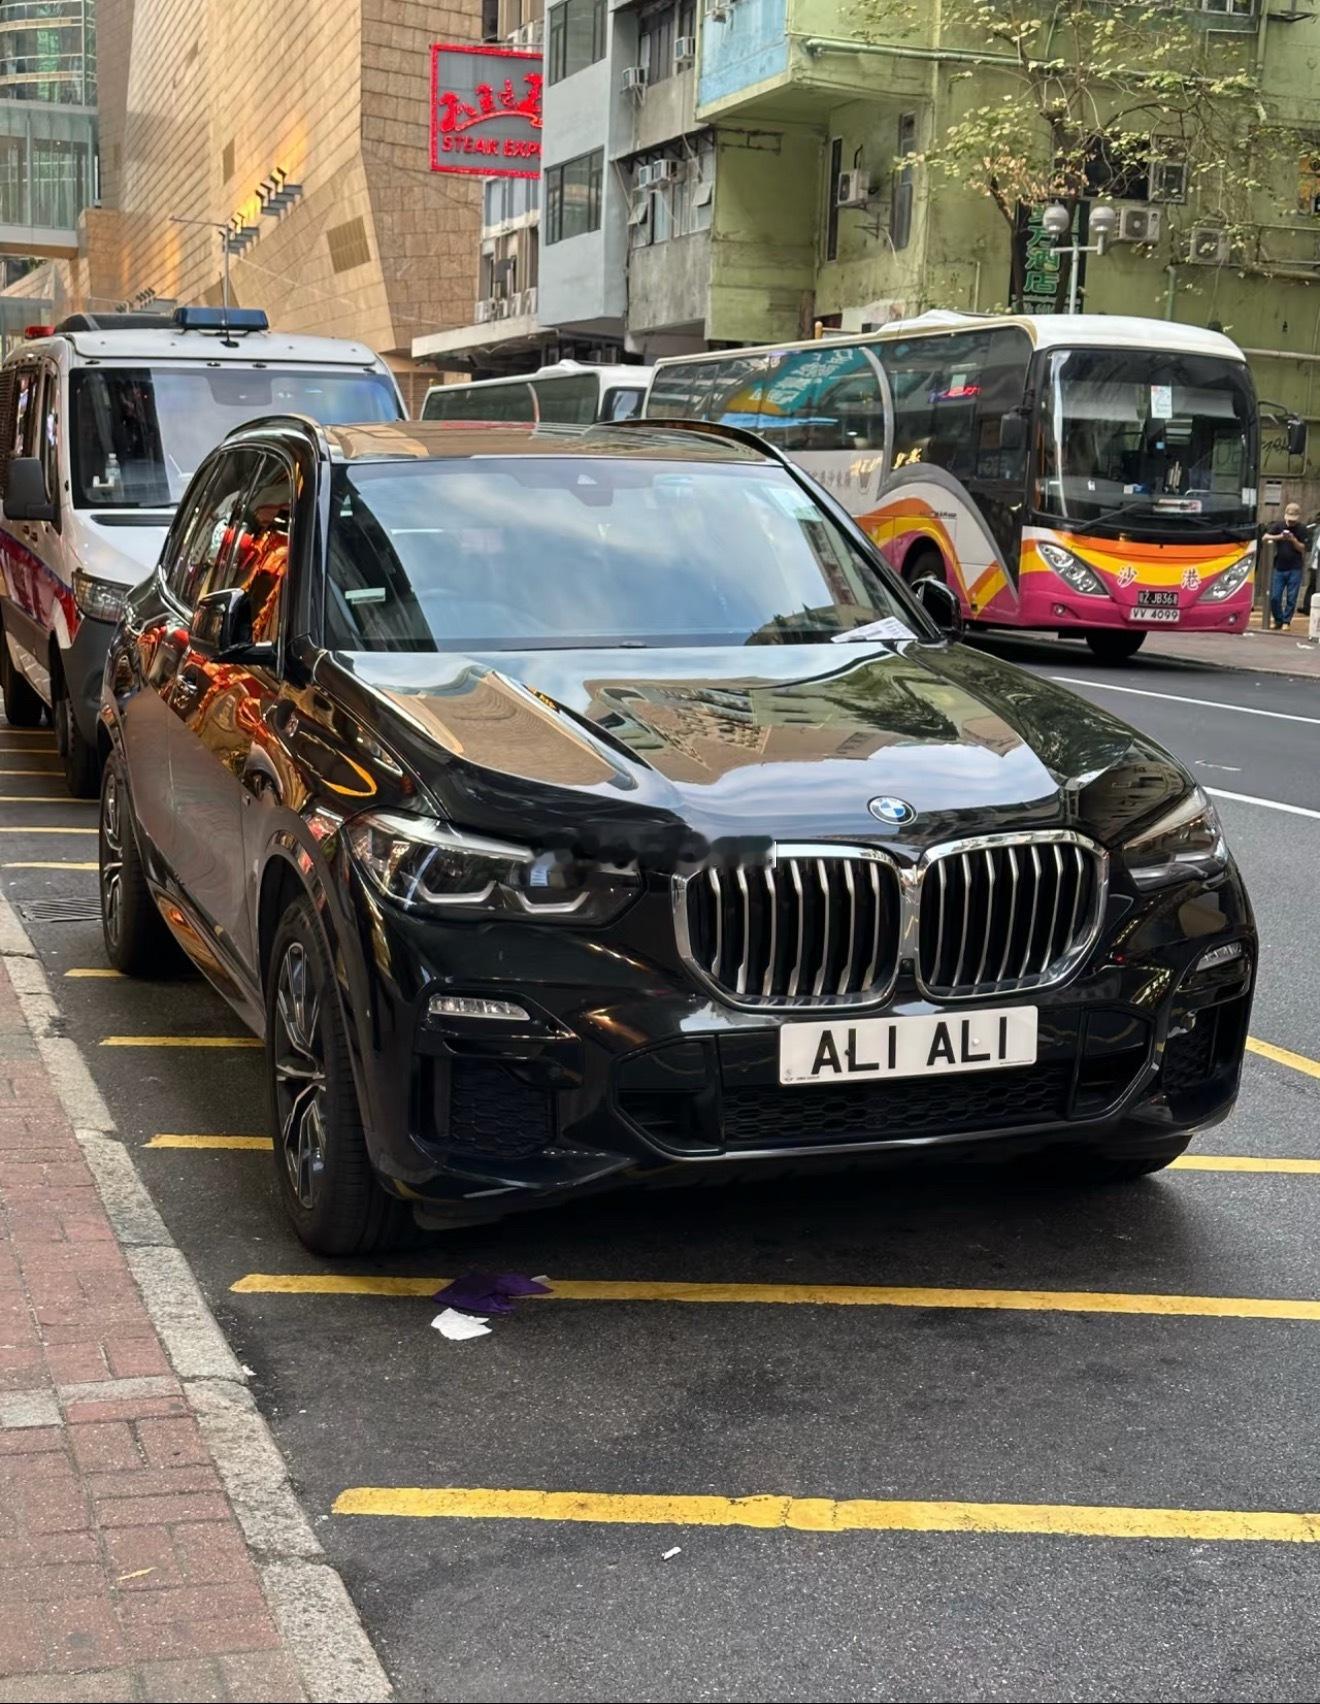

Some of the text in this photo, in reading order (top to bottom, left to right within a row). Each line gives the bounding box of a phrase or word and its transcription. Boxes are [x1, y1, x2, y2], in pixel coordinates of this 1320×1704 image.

[442, 135, 542, 158] STEAK EXP
[1117, 563, 1202, 591] 沙 港
